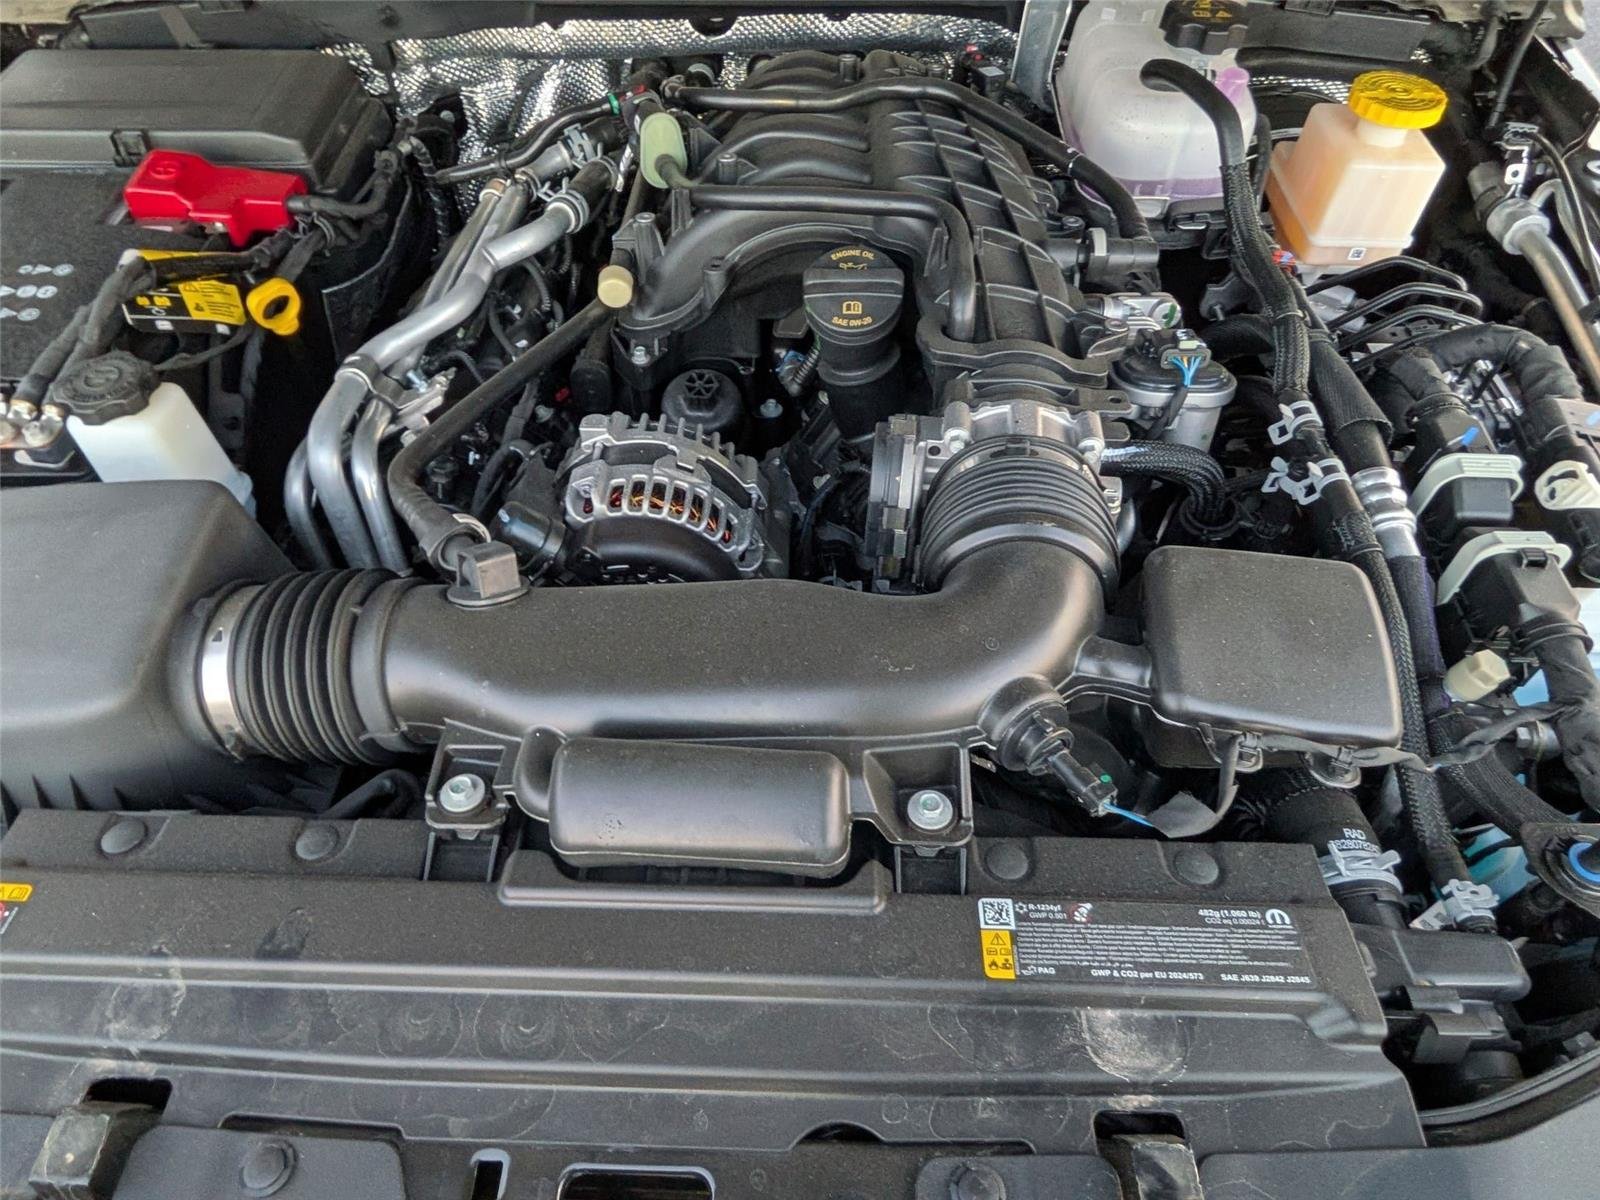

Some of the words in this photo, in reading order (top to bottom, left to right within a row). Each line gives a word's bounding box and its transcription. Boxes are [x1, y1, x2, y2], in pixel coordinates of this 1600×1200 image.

[831, 249, 861, 260] ENGINE
[862, 250, 875, 261] OIL
[832, 316, 849, 327] SAE
[849, 316, 873, 327] 0W-20
[1343, 827, 1366, 840] RAD
[1028, 903, 1061, 912] R-1234yf
[1029, 911, 1047, 919] GWP
[1204, 917, 1222, 925] CO2
[1037, 966, 1056, 975] PAG
[1090, 969, 1111, 977] GWP
[1112, 969, 1120, 978] &
[1120, 969, 1139, 978] CO2
[1139, 972, 1153, 980] per
[1154, 971, 1168, 979] EU
[1220, 973, 1240, 982] SAE
